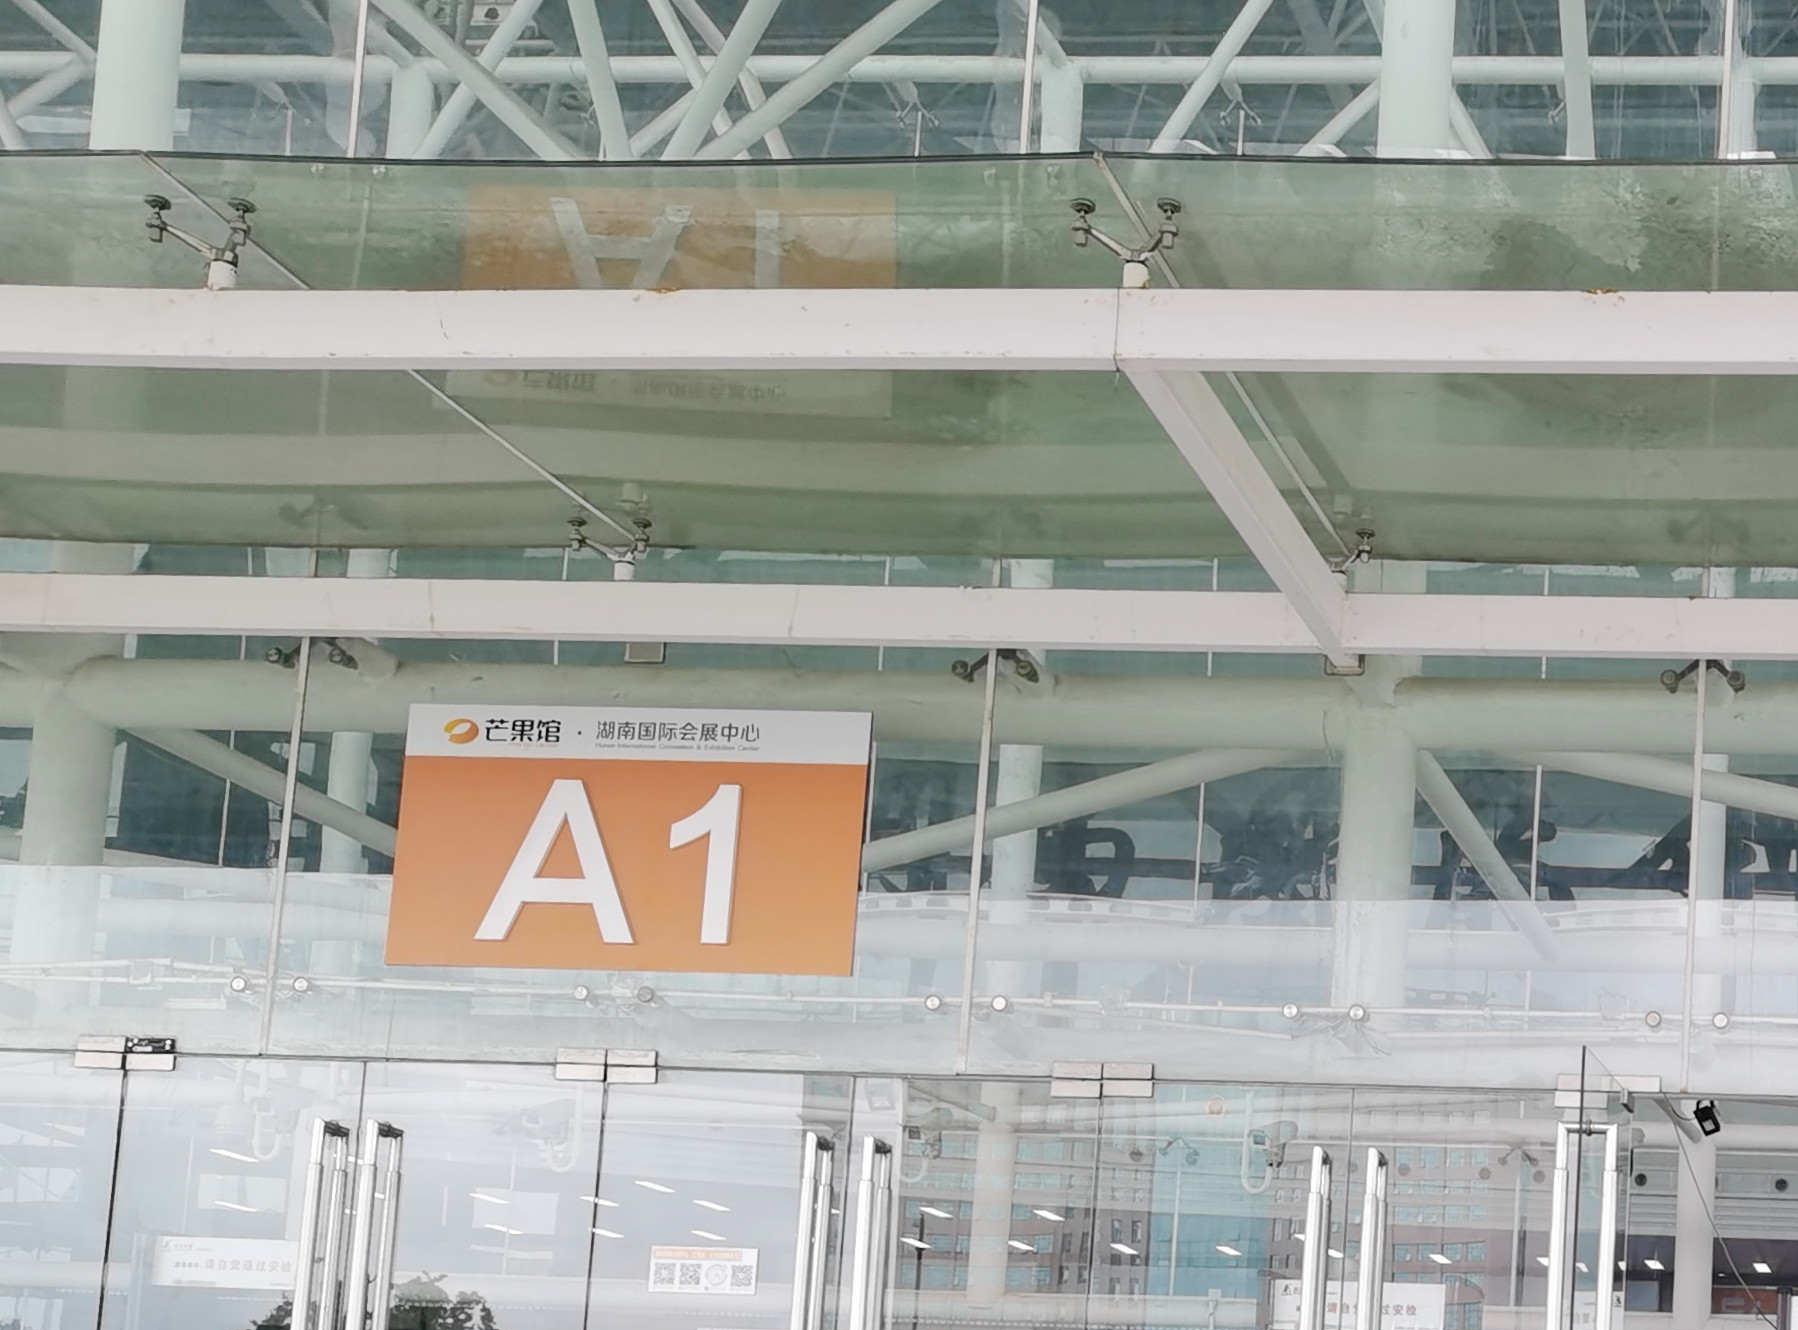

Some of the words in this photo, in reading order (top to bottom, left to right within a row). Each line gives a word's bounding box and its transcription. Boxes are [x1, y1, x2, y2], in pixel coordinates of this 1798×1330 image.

[485, 719, 562, 743] 芒果馆
[596, 721, 761, 743] 湖南国际会展中心
